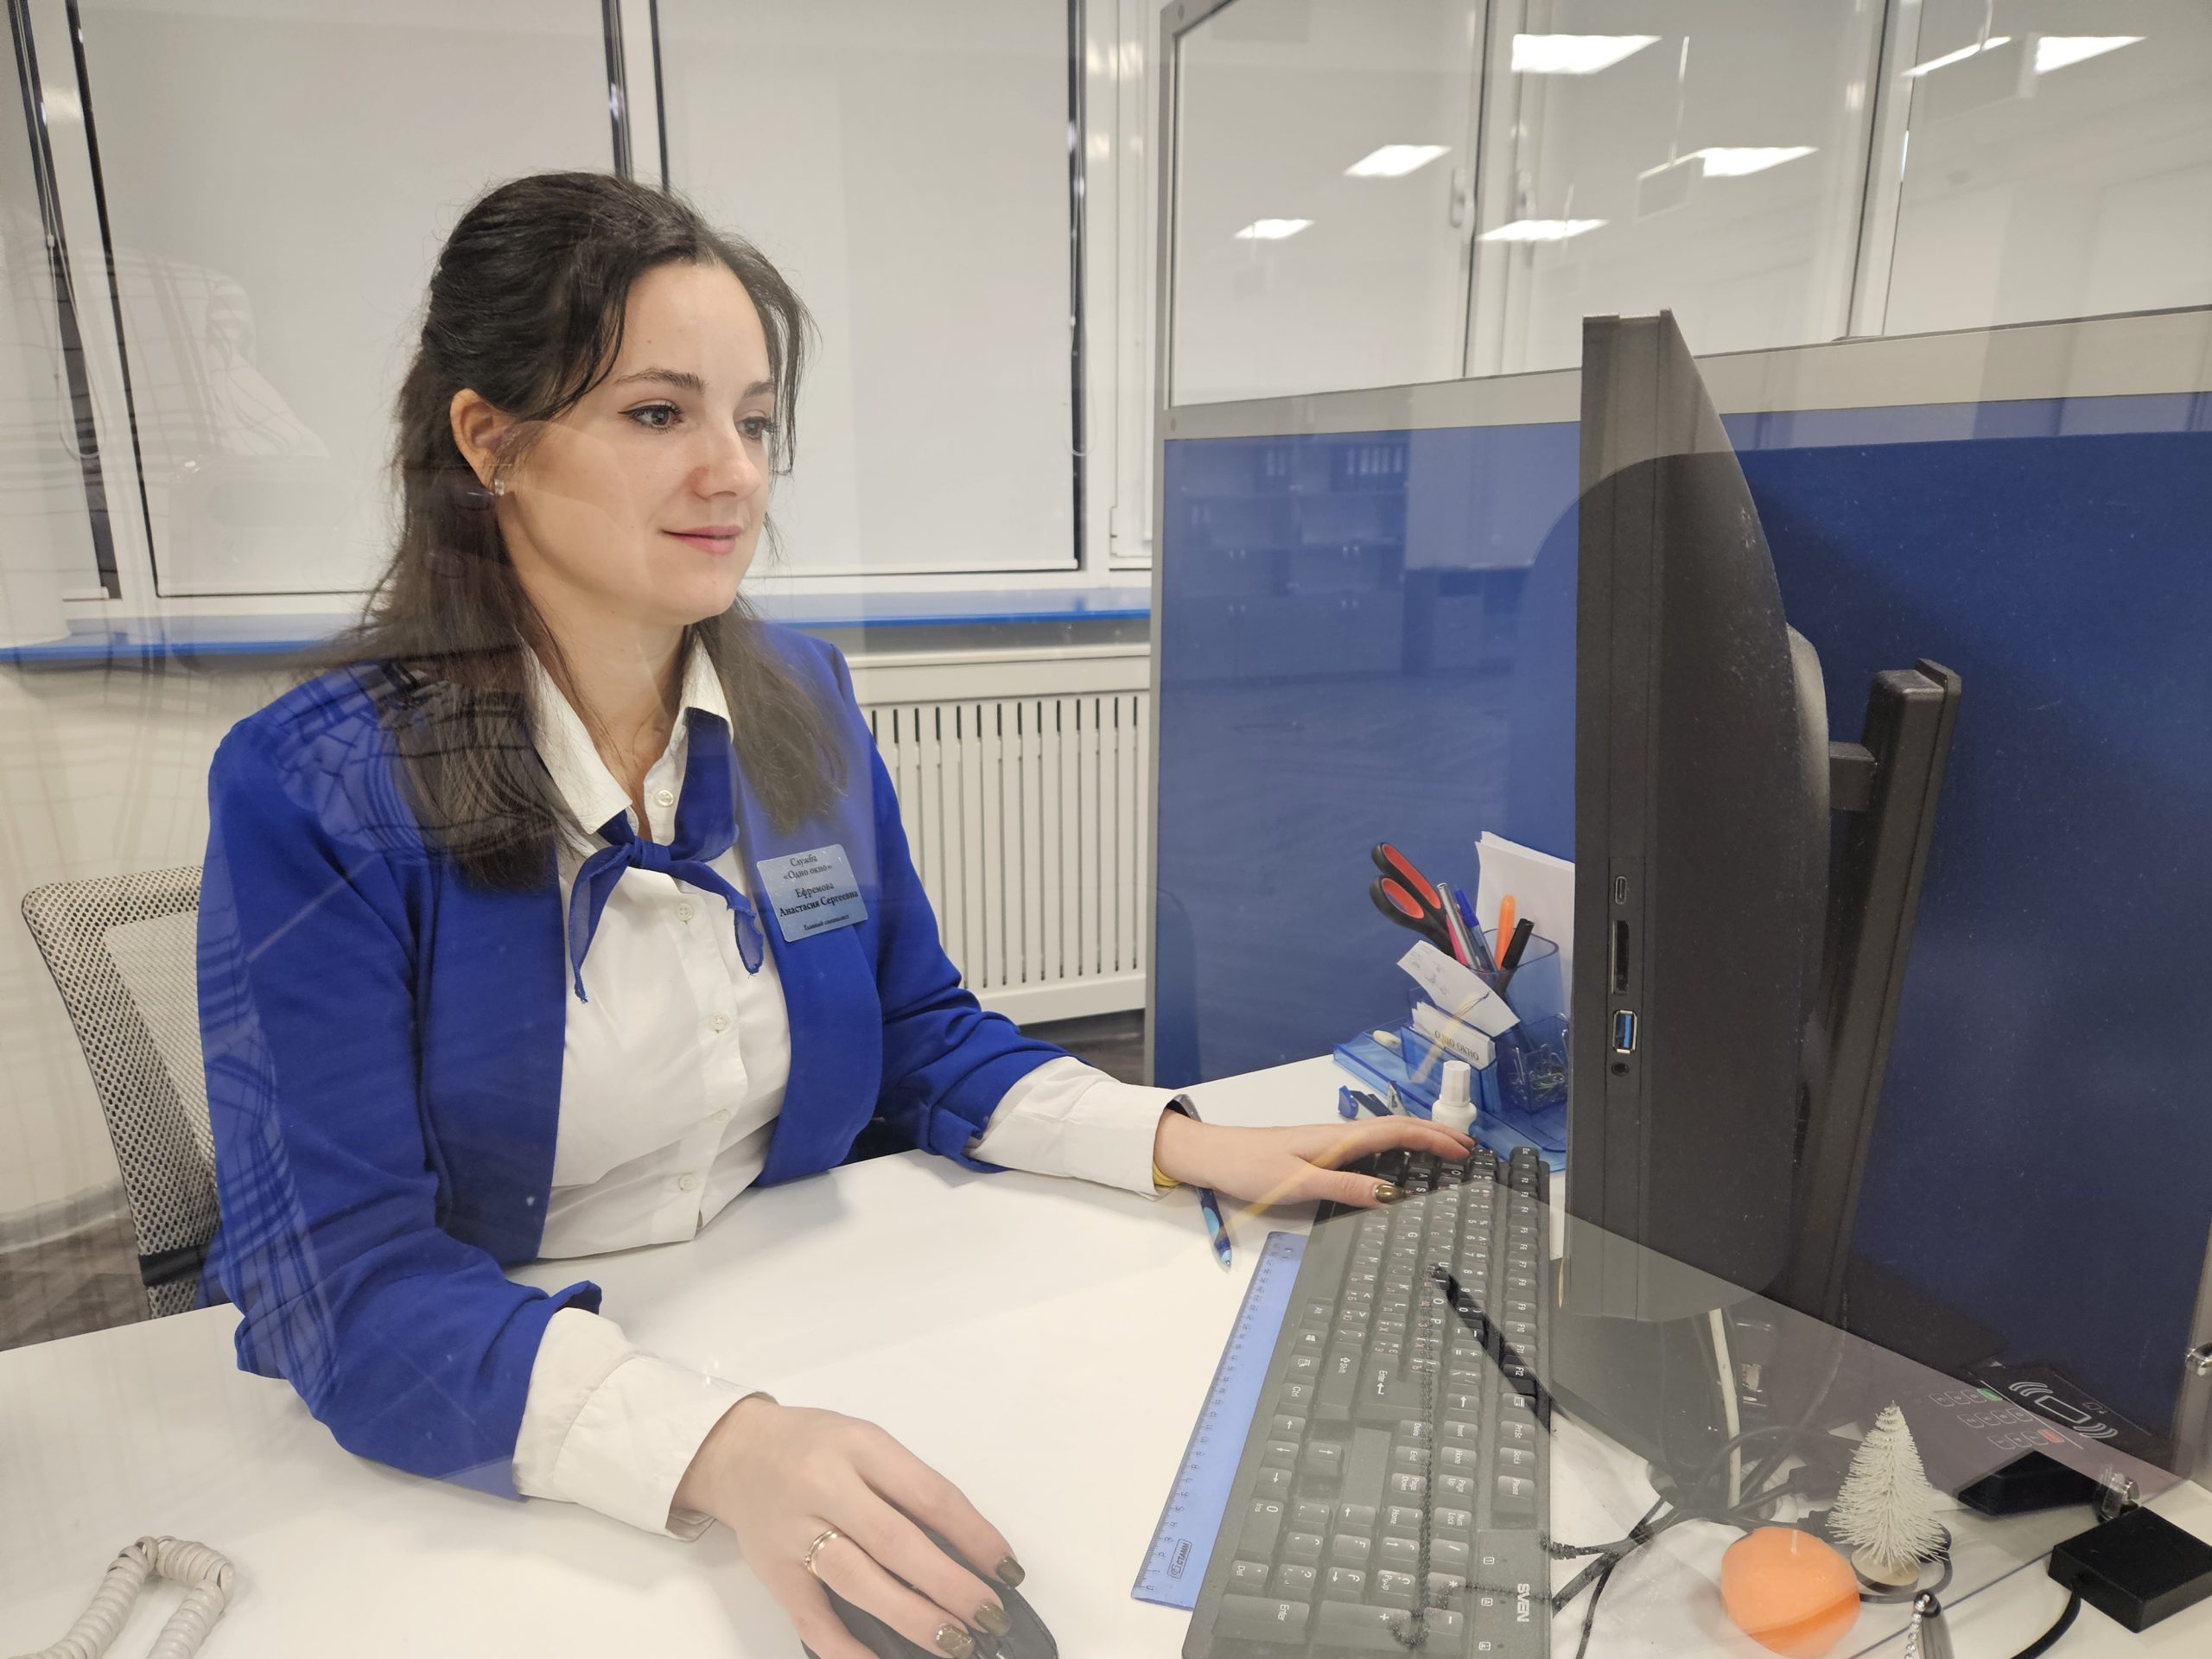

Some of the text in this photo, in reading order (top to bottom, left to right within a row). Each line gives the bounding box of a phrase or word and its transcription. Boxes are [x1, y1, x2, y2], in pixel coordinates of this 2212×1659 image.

[790, 854, 817, 867] Служба
[795, 883, 835, 899] Ефремова
[779, 890, 859, 917] Анастасия Сергеевна
[1457, 1042, 1479, 1061] ОКНО
[1291, 1386, 1301, 1398] Ctrl
[1236, 1565, 1246, 1577] Del
[1516, 1582, 1530, 1623] SVEN
[1277, 1604, 1290, 1621] Enter
